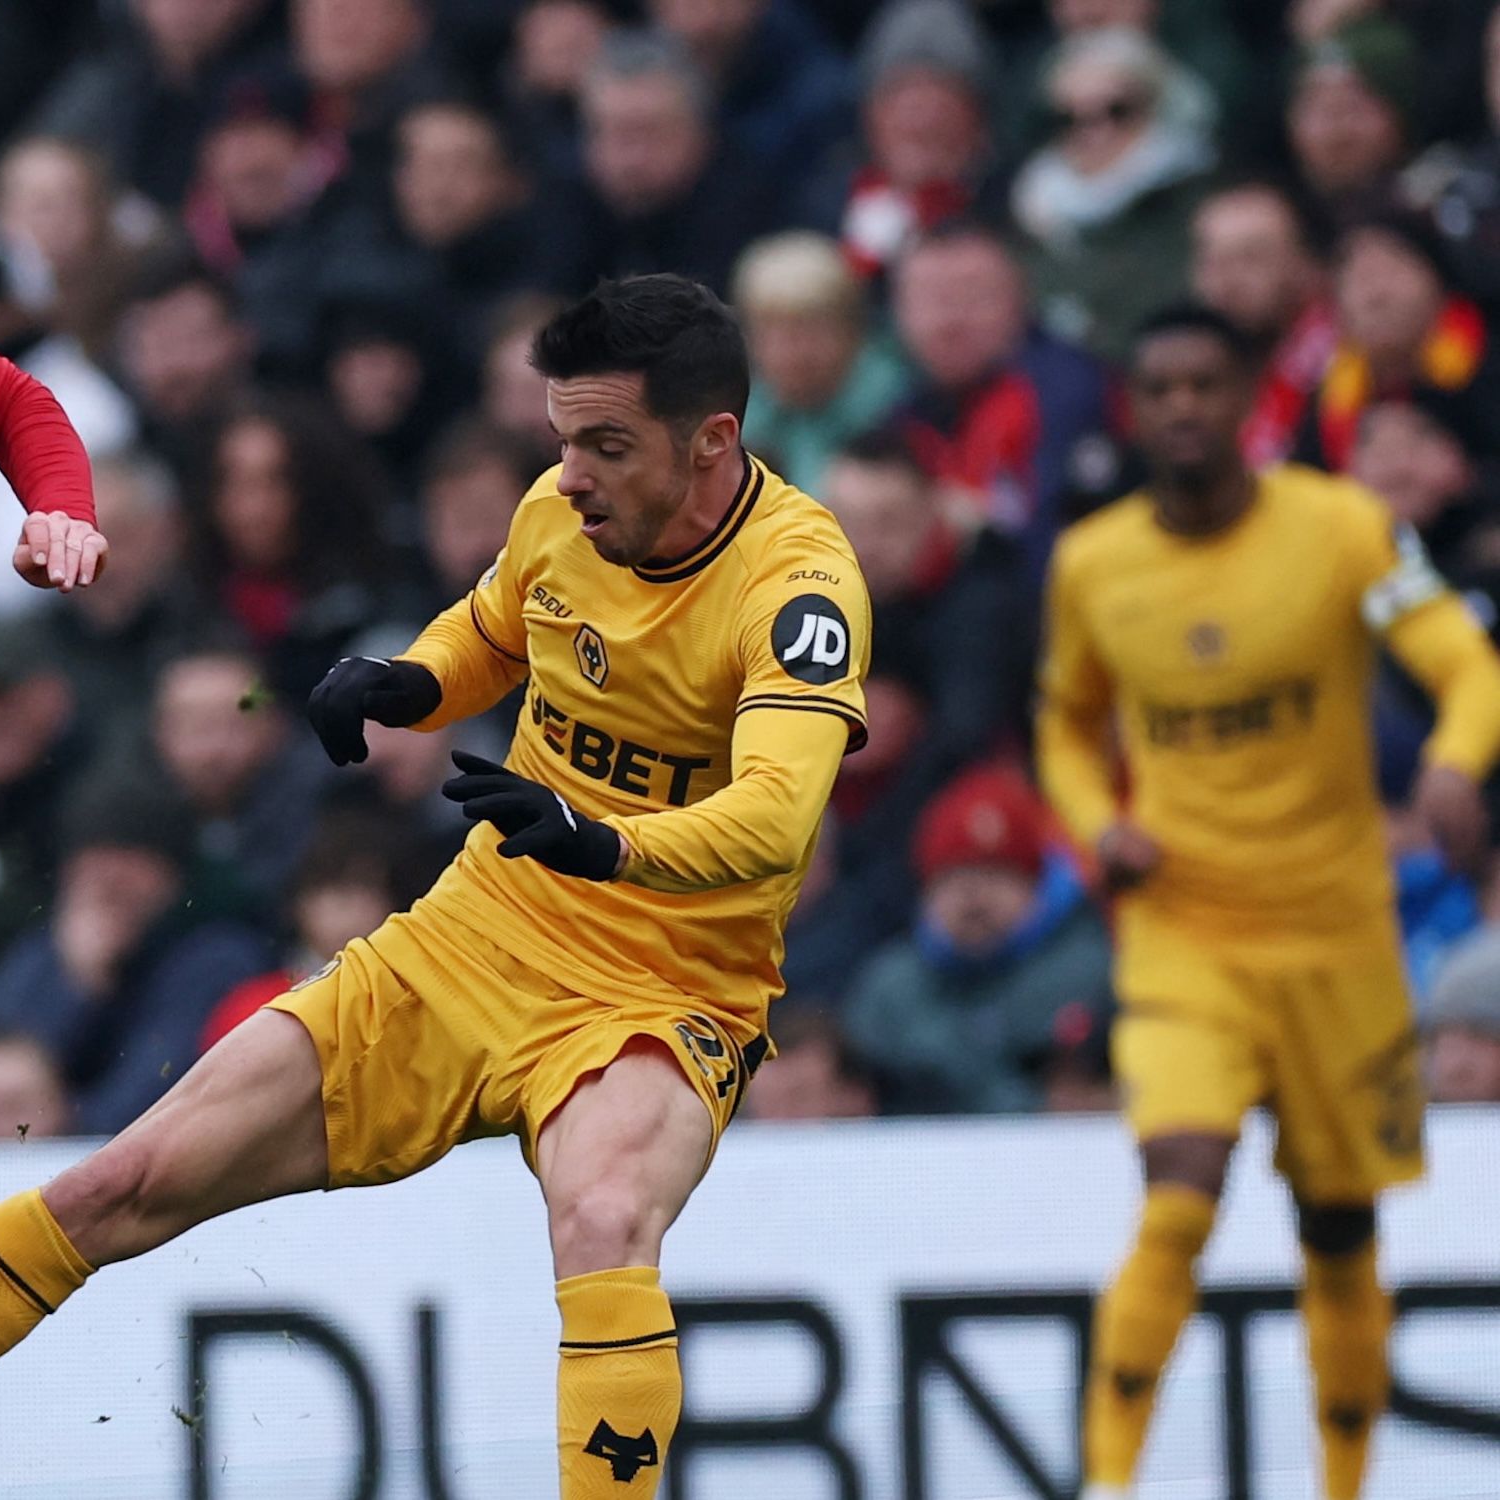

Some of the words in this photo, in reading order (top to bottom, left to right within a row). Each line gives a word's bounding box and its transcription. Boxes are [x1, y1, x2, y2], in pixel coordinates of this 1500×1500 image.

[786, 570, 841, 585] SUDU
[532, 586, 573, 618] SUDU
[783, 613, 847, 667] JD
